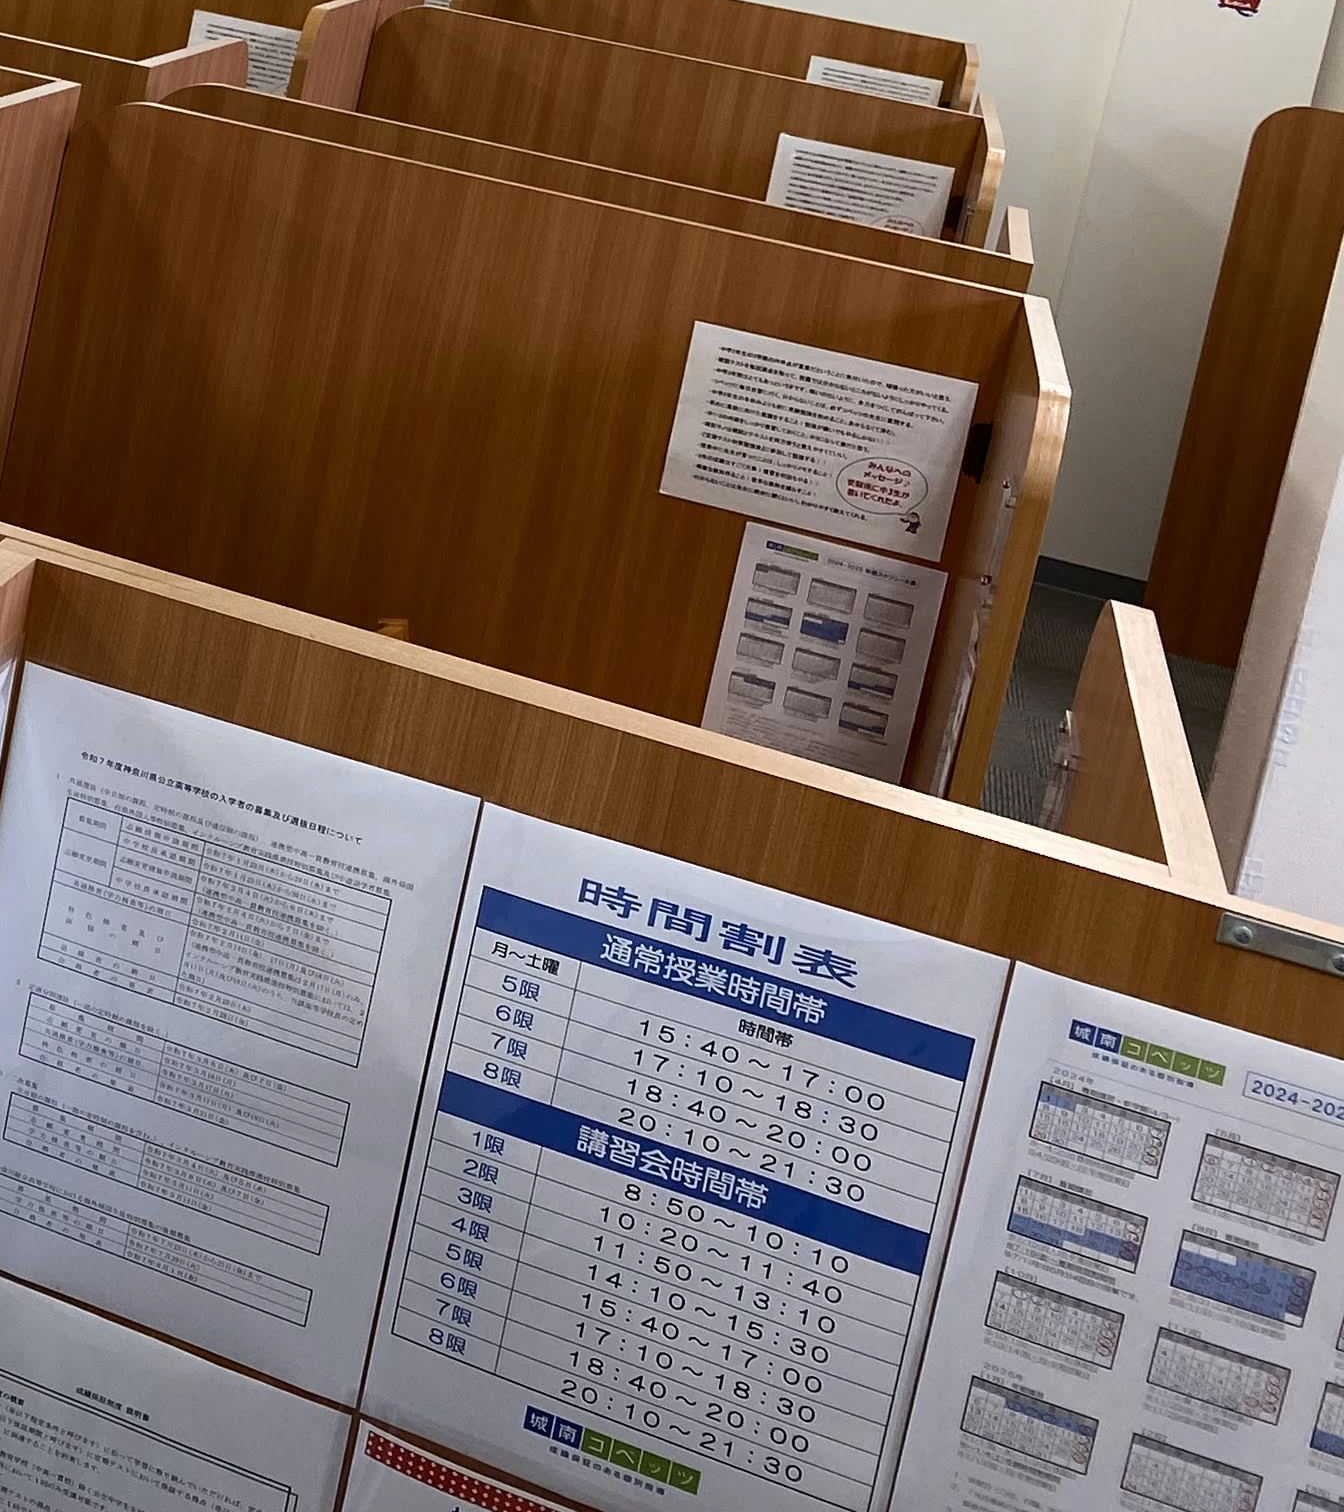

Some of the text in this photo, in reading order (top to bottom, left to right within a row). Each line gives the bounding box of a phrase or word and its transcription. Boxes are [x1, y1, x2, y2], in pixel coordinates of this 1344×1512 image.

[578, 877, 858, 988] 時間割表
[500, 974, 541, 1003] 5限
[599, 933, 827, 1025] 通常授業時間帯
[494, 1003, 535, 1032] 6限
[489, 1032, 529, 1061] 7限
[737, 1018, 794, 1049] 時間帯
[1074, 1025, 1220, 1079] 城南コベッツ
[482, 1061, 522, 1090] 8限
[472, 1129, 506, 1157] 1限
[463, 1158, 500, 1186] 2限
[576, 1123, 769, 1210] 講習会時間帯
[457, 1186, 493, 1214] 3限
[451, 1215, 490, 1244] 4限
[445, 1244, 484, 1272] 5限
[439, 1272, 478, 1300] 6限
[434, 1300, 473, 1327] 7限
[428, 1327, 466, 1356] 8限
[528, 1414, 695, 1488] 城南コベッツ
